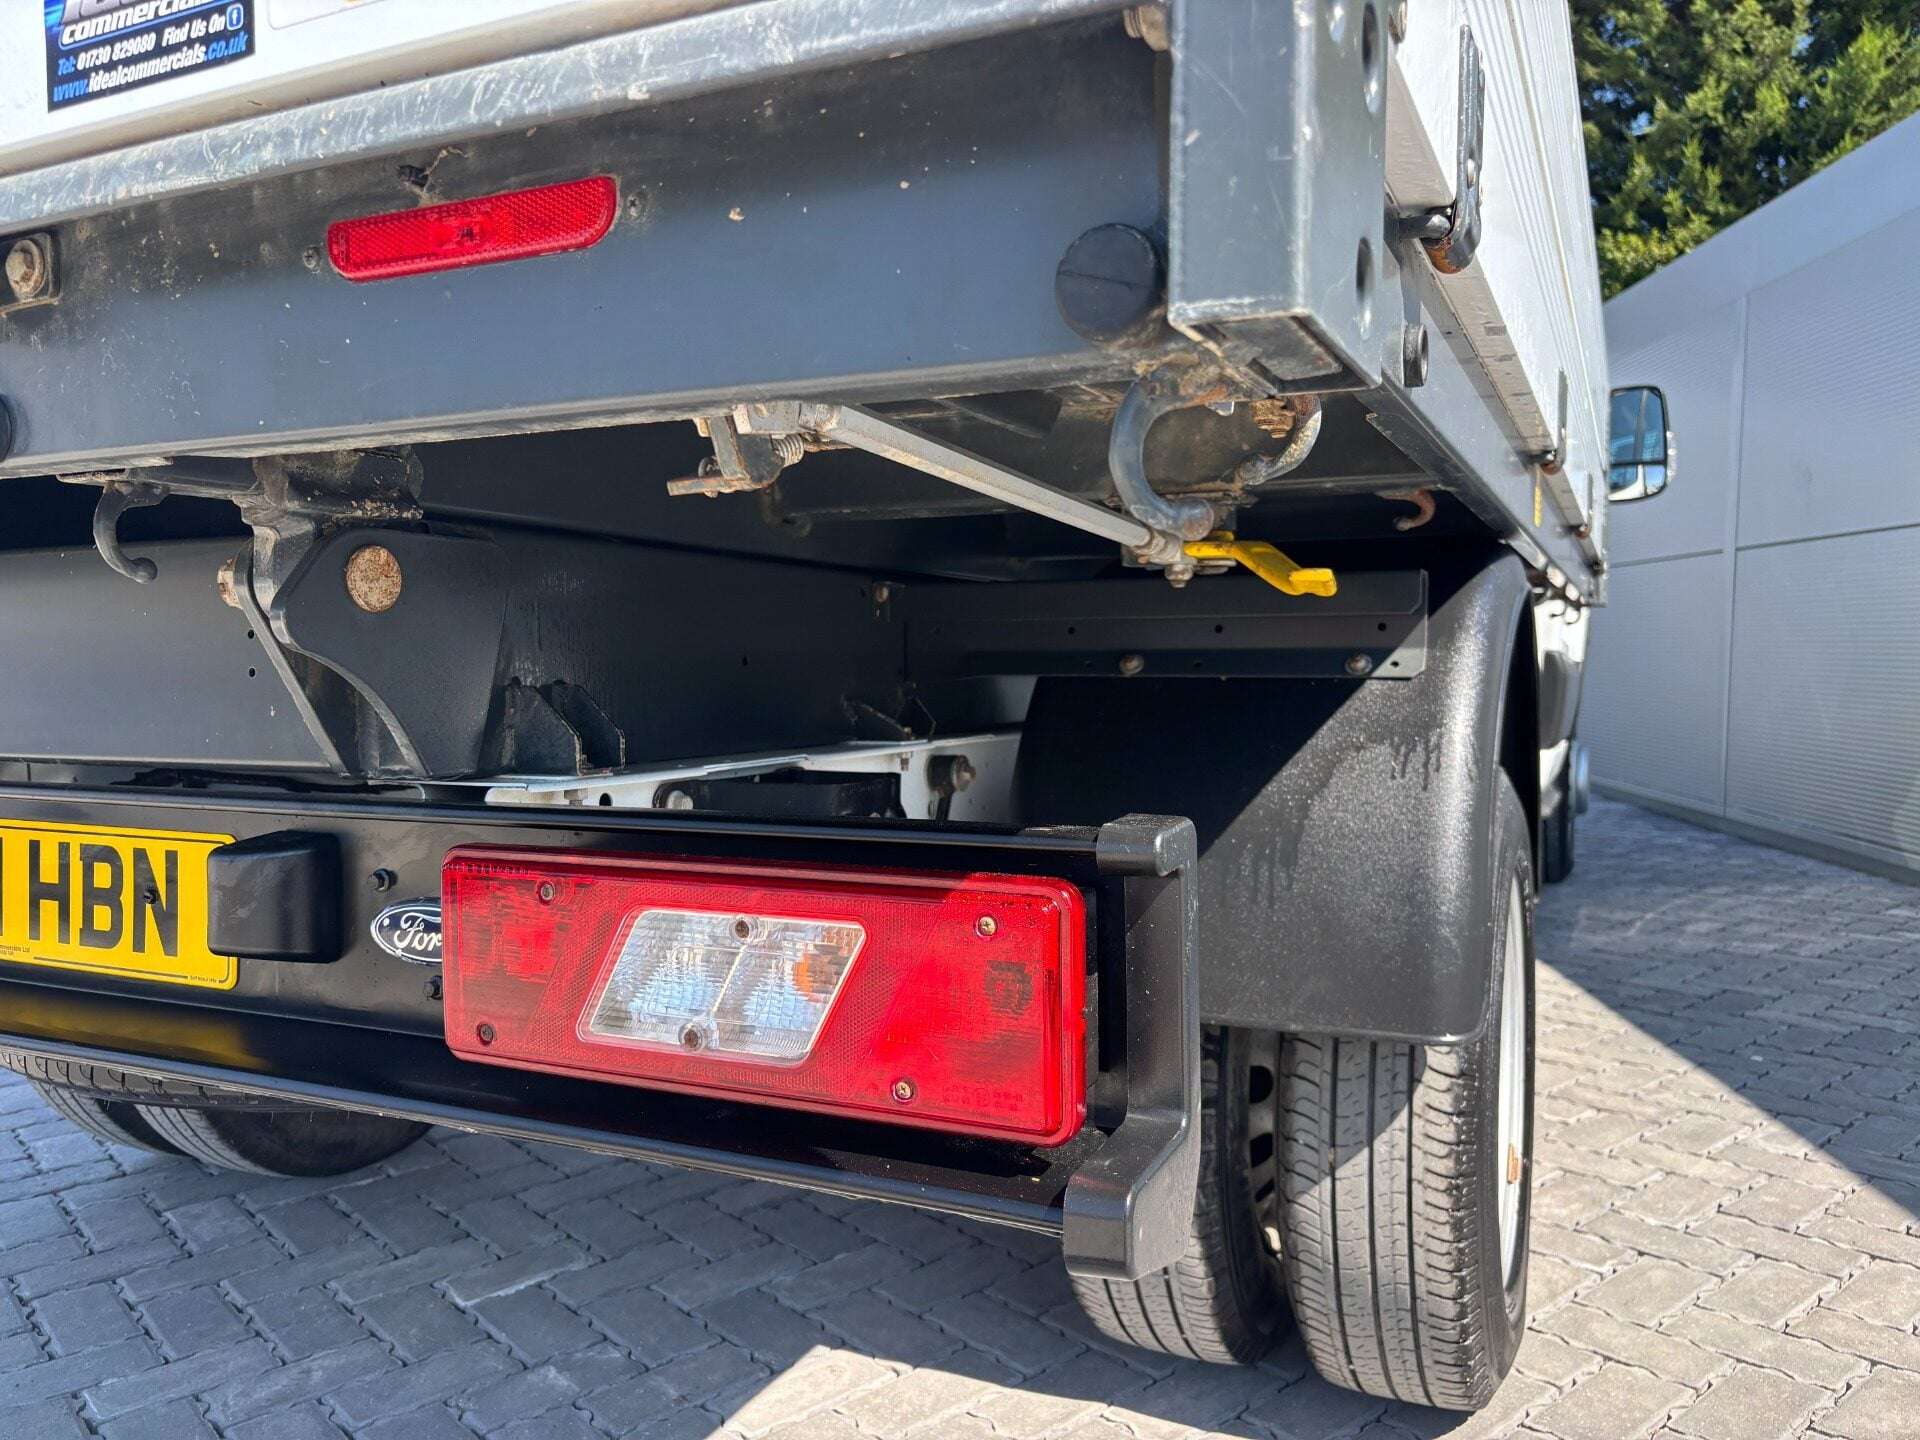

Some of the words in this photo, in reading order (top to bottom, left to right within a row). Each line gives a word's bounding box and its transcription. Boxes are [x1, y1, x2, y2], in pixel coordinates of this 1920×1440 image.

[53, 31, 248, 102] www.idealcommercials.co.uk
[57, 57, 76, 75] Tel:
[76, 45, 111, 70] 01730
[112, 32, 156, 61] 829080
[161, 23, 189, 47] Find
[190, 18, 207, 38] Us
[208, 13, 226, 33] On
[28, 839, 179, 957] HBN
[393, 911, 442, 951] For
